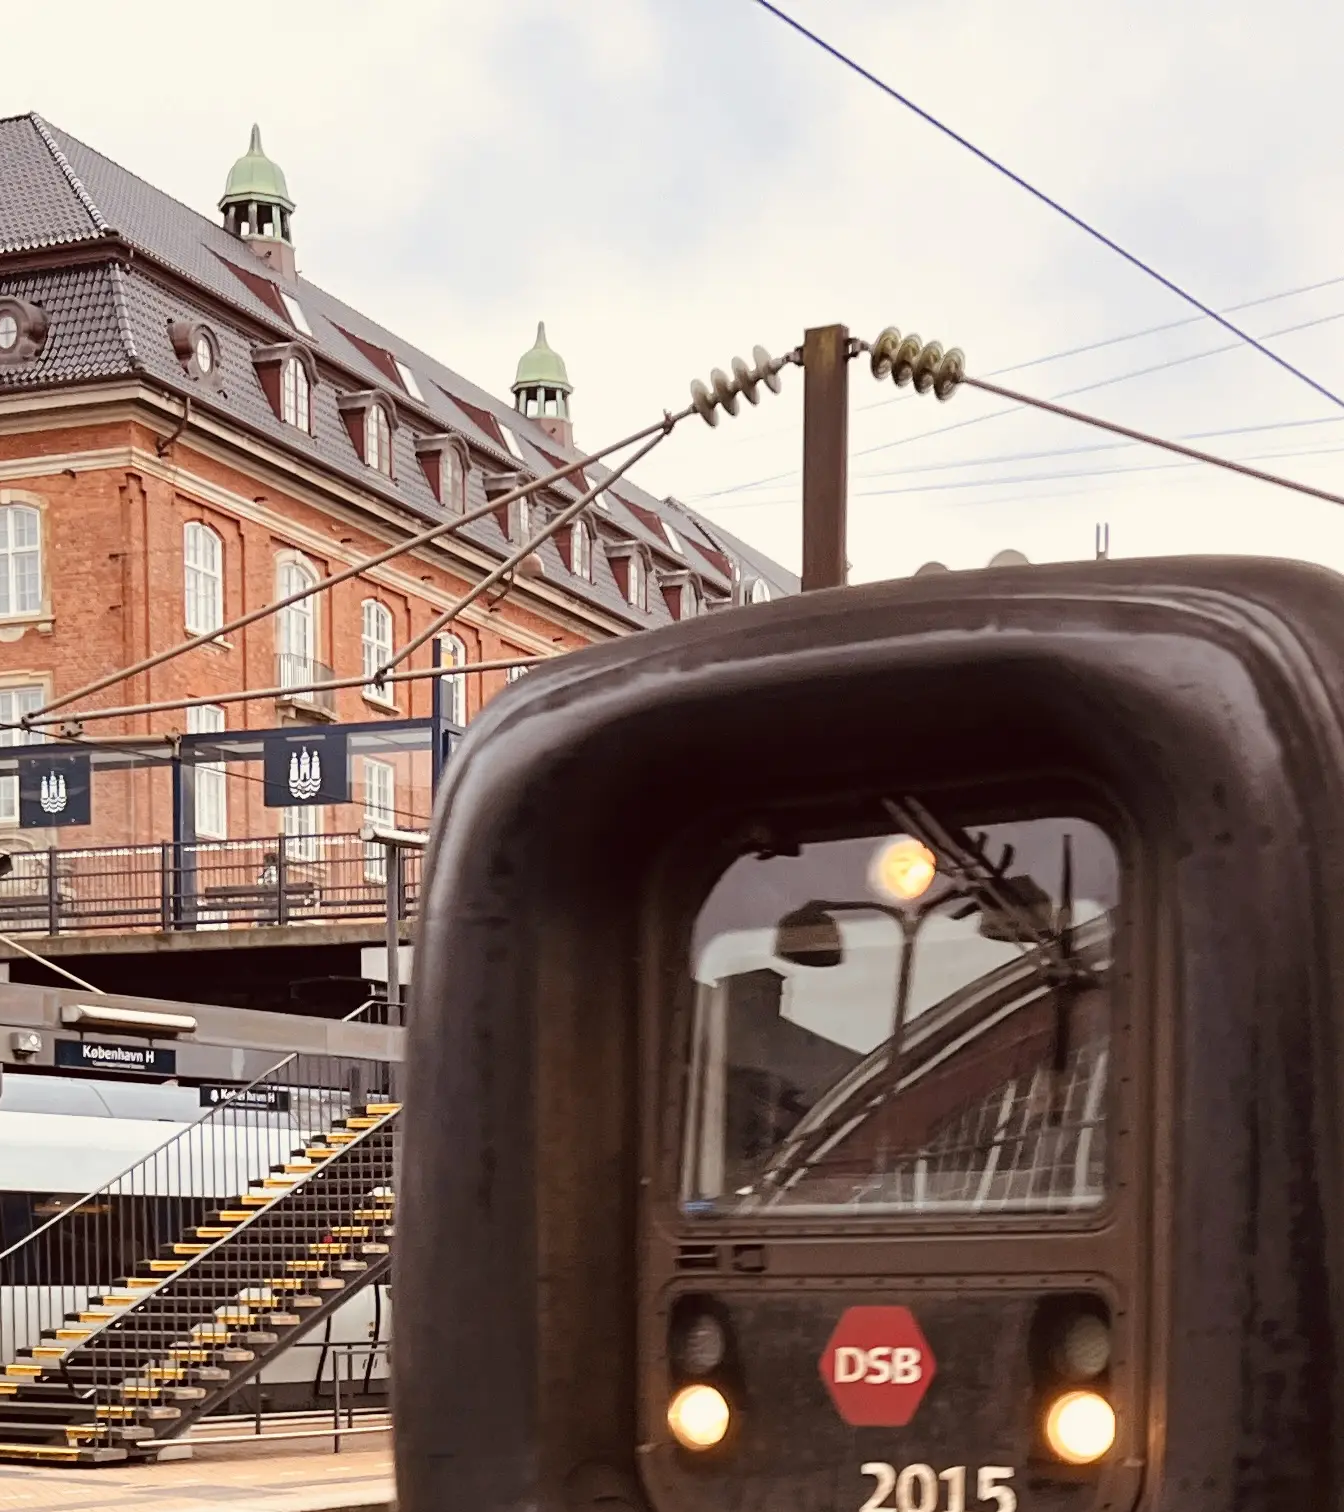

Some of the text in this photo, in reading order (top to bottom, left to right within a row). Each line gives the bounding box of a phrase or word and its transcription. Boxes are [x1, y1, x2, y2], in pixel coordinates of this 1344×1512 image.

[82, 1044, 155, 1063] København H
[833, 1346, 922, 1384] DSB
